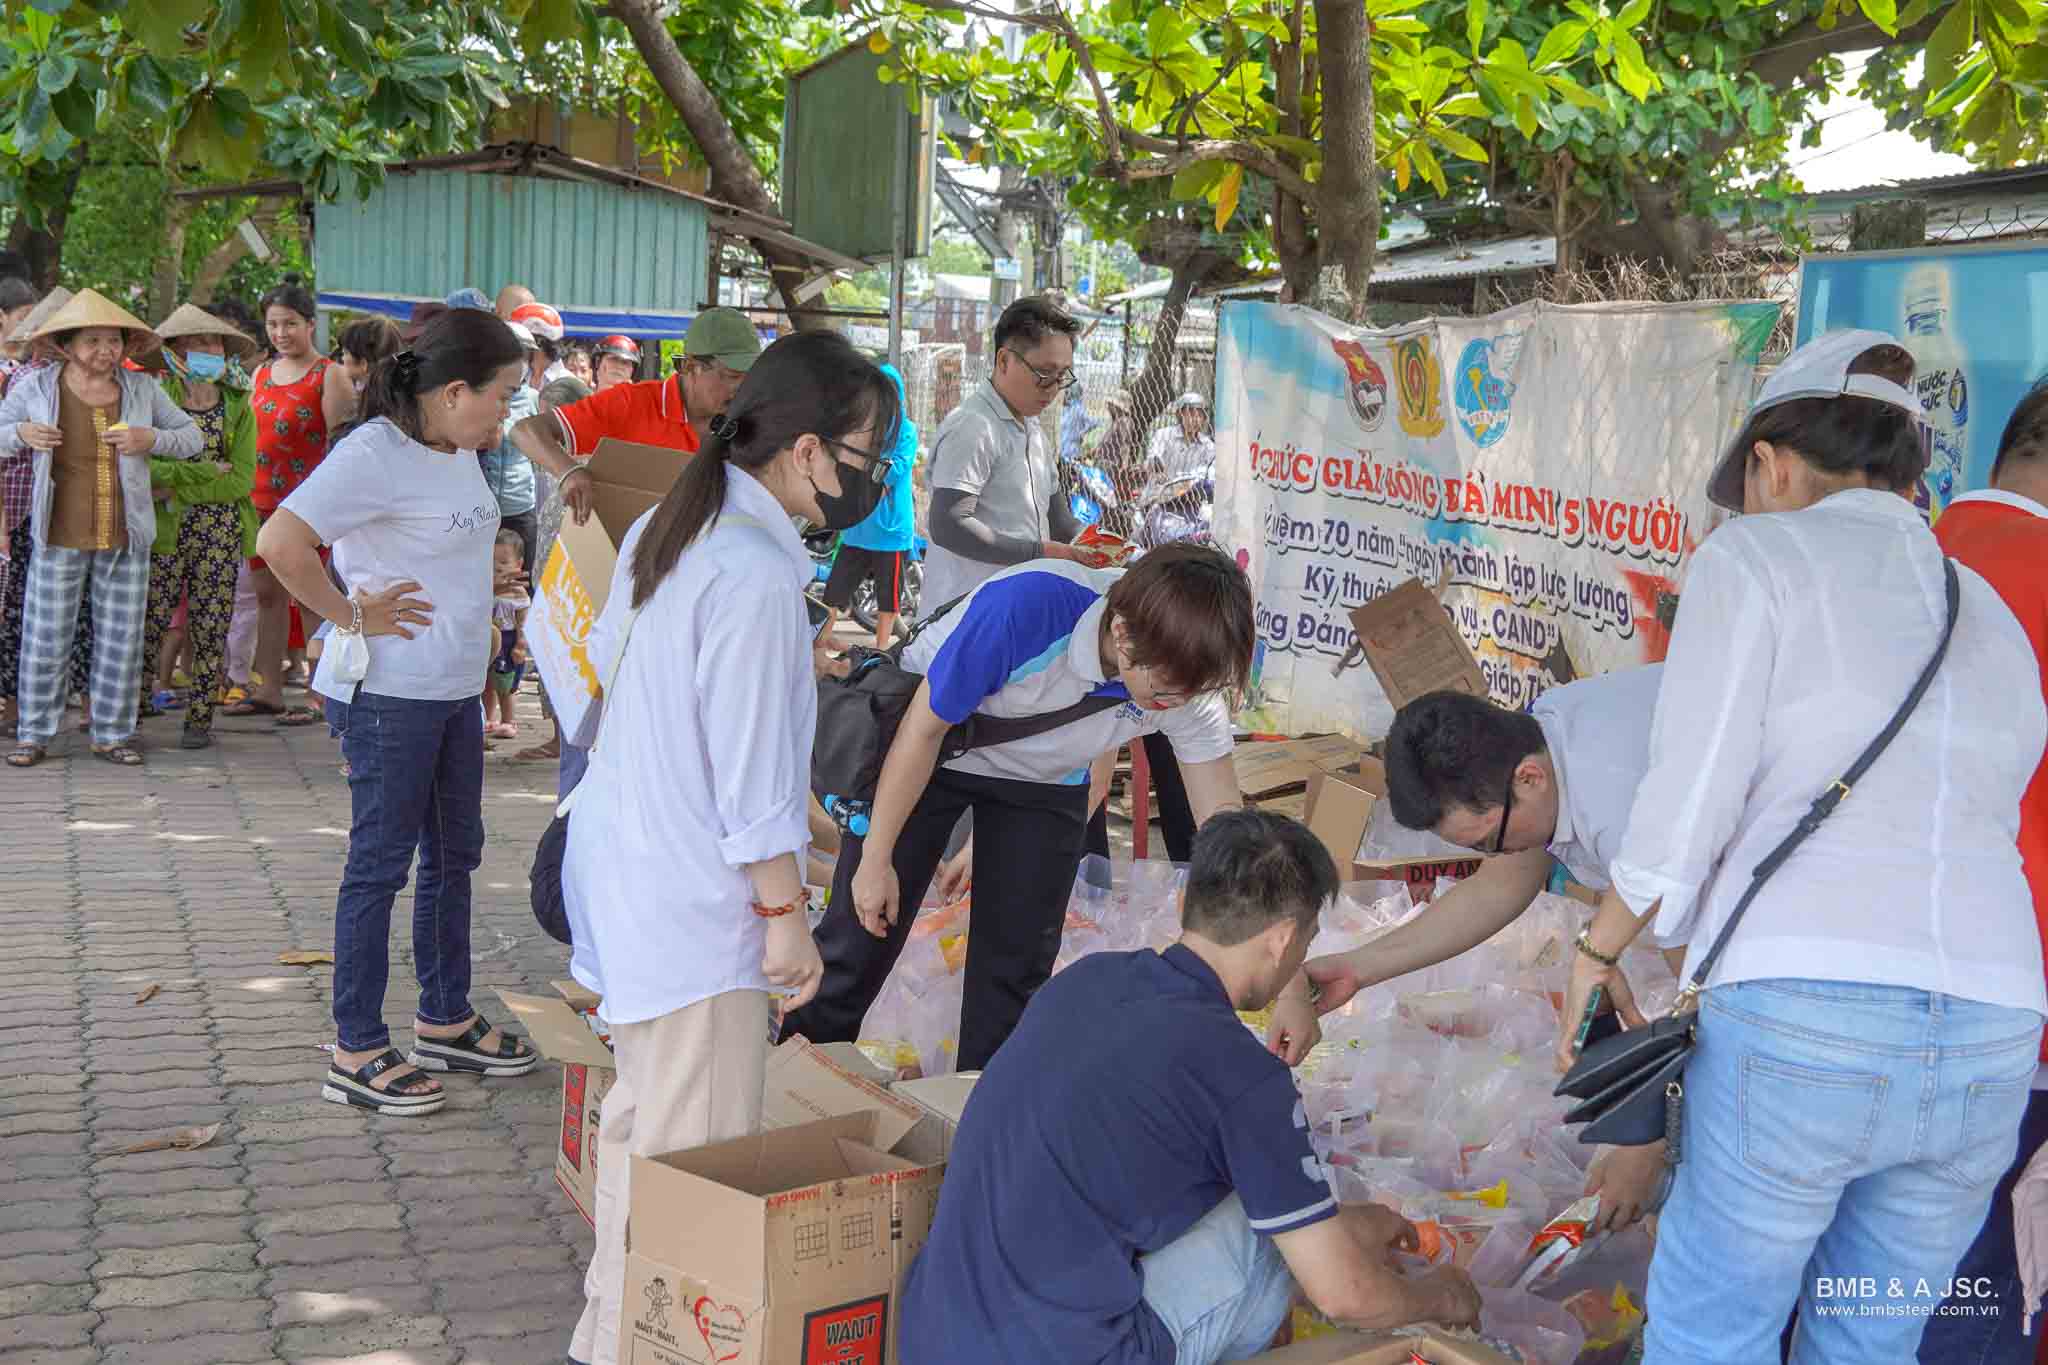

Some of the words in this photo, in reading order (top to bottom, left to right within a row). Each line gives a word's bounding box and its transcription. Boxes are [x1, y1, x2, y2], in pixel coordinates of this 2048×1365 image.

[440, 511, 473, 533] Key
[1491, 482, 1556, 527] MINI
[1563, 499, 1580, 536] 5
[1586, 496, 1681, 554] NGƯỜI
[1303, 564, 1336, 600] Kỹ
[1323, 519, 1350, 547] 70
[1357, 525, 1395, 558] năm
[1438, 545, 1498, 582] thành
[1504, 555, 1536, 596] lập
[1541, 563, 1567, 605] lực
[1574, 571, 1630, 626] lượng
[1410, 862, 1449, 882] DUY
[826, 1312, 878, 1346] WANT
